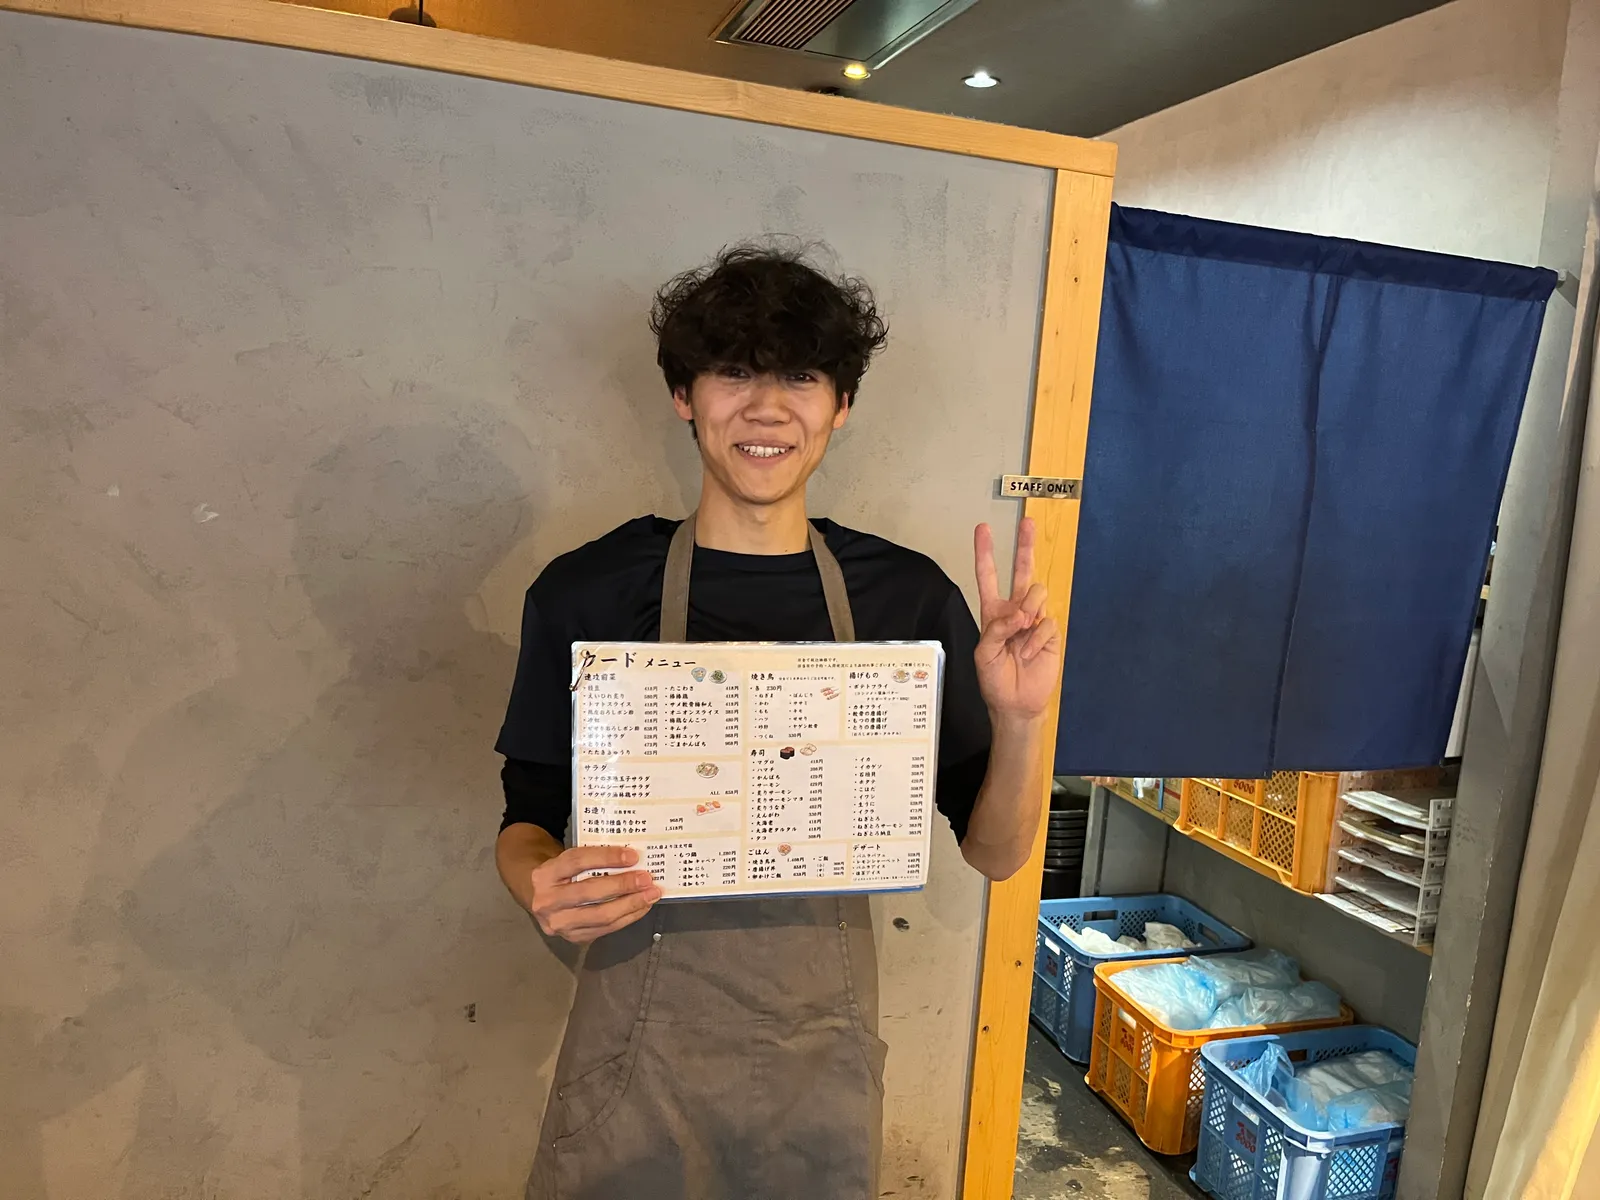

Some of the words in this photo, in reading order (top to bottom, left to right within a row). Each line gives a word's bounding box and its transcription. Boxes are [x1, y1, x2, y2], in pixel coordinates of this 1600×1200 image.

[1010, 482, 1042, 492] STAFF
[1047, 483, 1075, 493] ONLY
[644, 658, 697, 668] メニュー
[584, 764, 607, 772] サラダ
[1233, 779, 1255, 795] 5000
[584, 806, 606, 814] お造り
[853, 843, 881, 852] デザート
